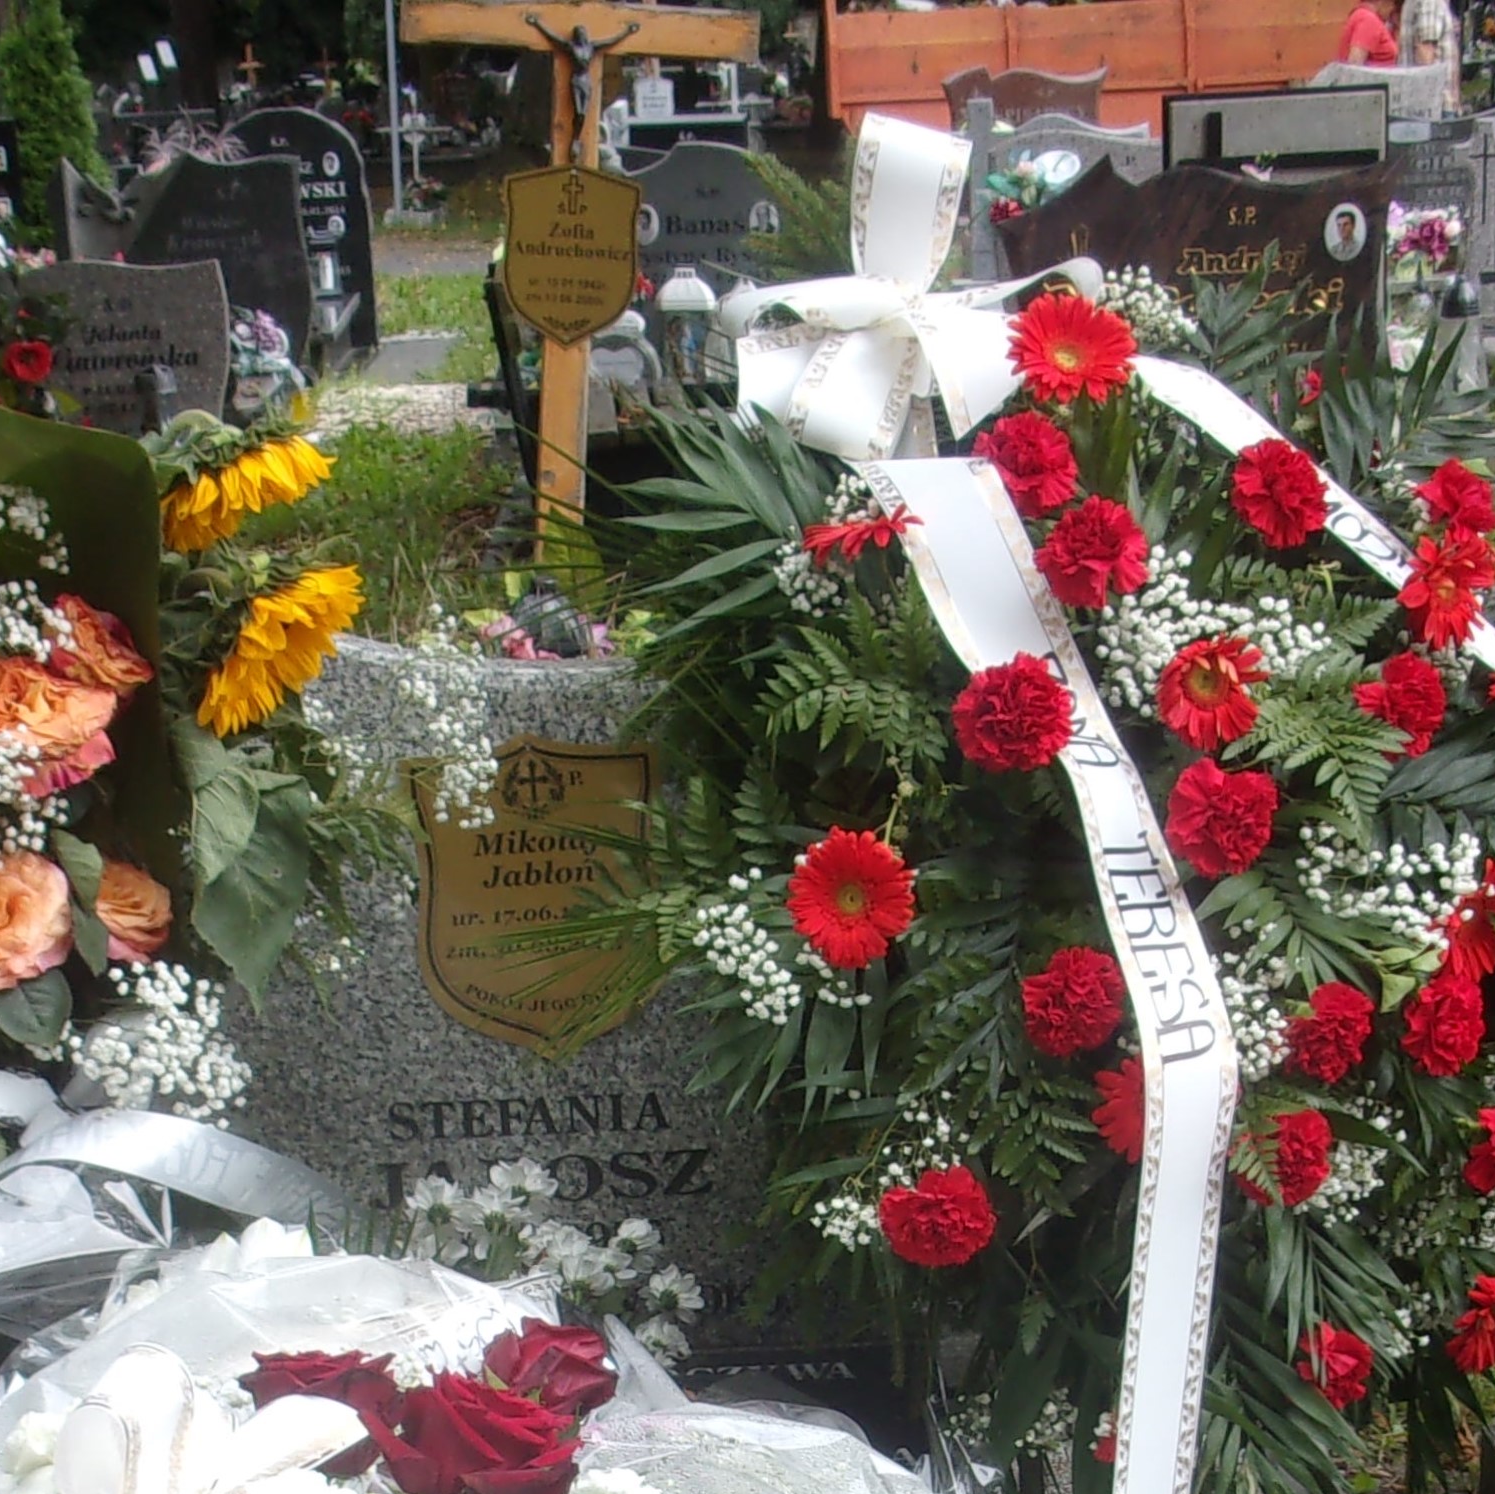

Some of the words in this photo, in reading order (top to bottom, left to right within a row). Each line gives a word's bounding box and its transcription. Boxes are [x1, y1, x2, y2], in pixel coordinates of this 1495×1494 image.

[548, 221, 595, 240] Zofia
[515, 240, 632, 262] Andruchowicz
[452, 911, 485, 928] ur.
[387, 1090, 672, 1142] STEFANIA
